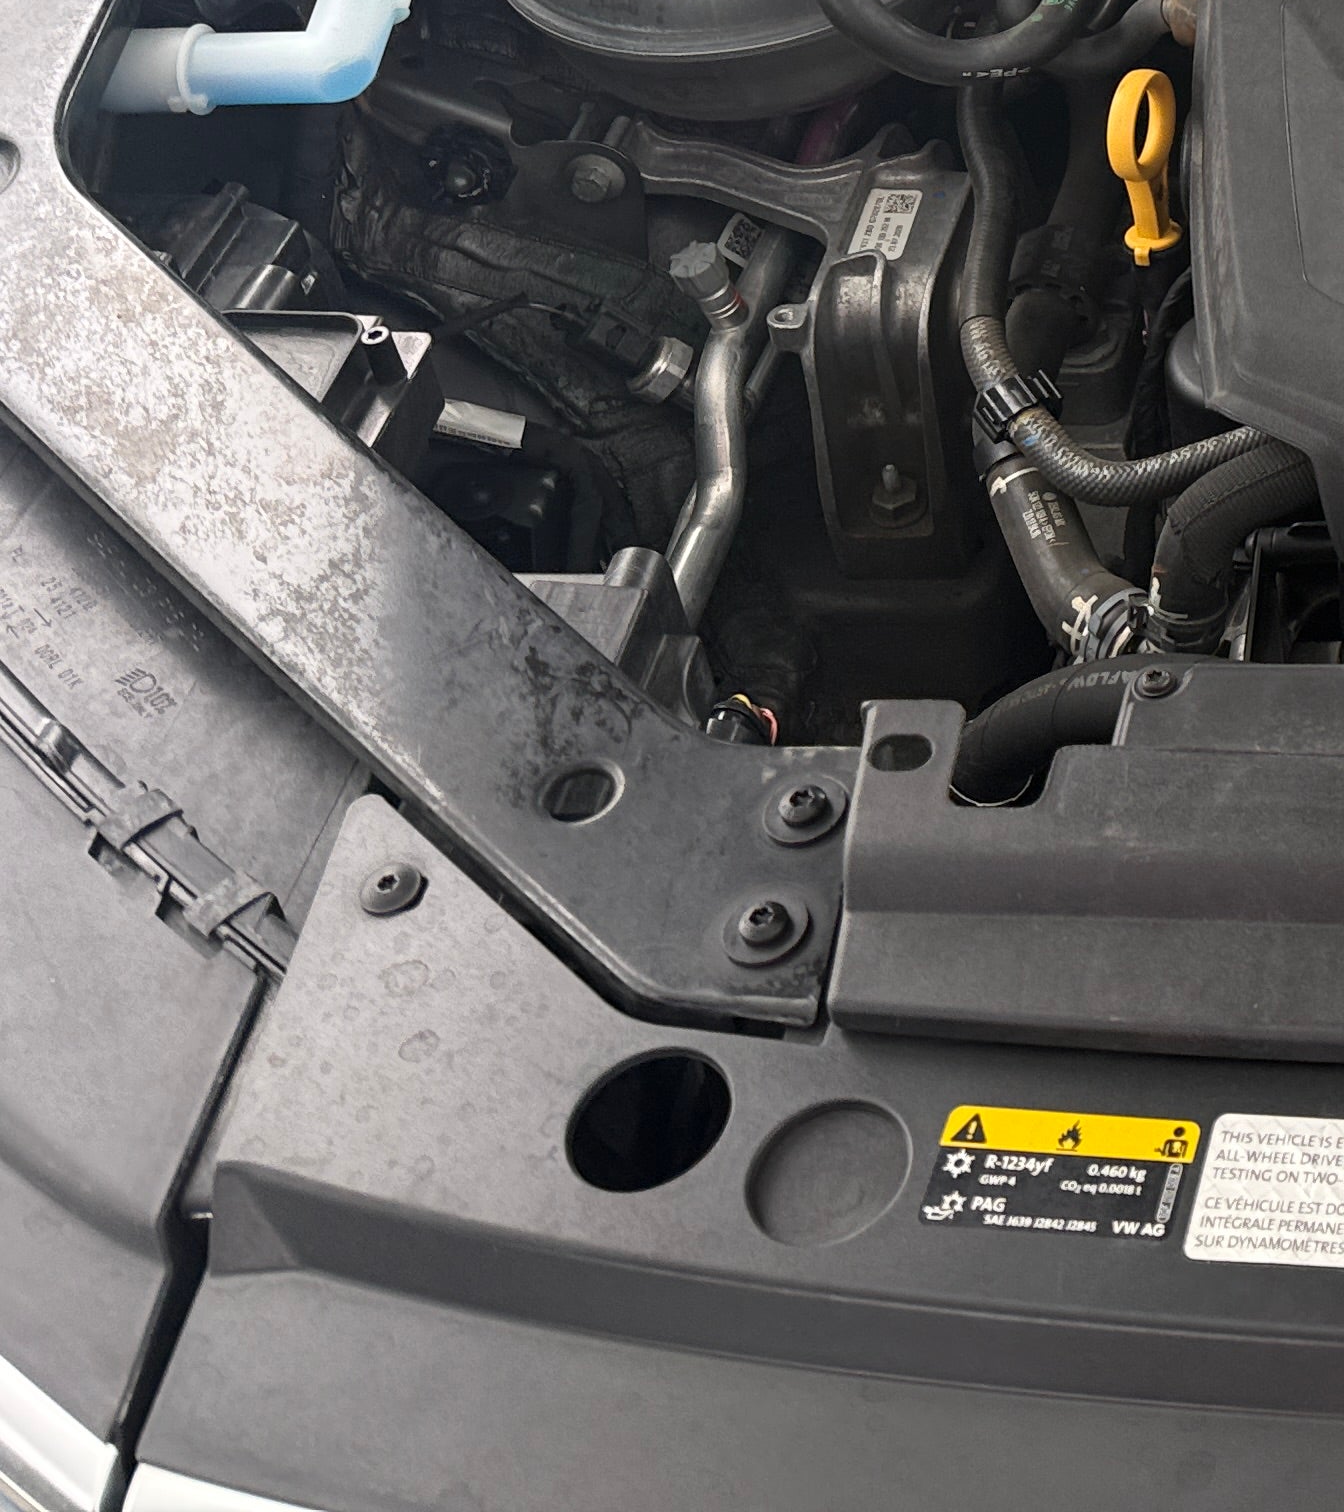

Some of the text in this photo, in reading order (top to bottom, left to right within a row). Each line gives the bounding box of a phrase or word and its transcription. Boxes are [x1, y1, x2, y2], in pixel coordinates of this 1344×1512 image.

[1221, 1130, 1253, 1144] THIS
[1259, 1133, 1314, 1148] VEHICLE
[1319, 1137, 1332, 1148] IS
[984, 1155, 1054, 1177] R-1234yf
[1215, 1149, 1297, 1164] ALL-WHEEL
[1300, 1153, 1344, 1167] DRIVE
[1087, 1164, 1147, 1183] 0.460 kg
[1213, 1167, 1273, 1182] TESTING
[1276, 1170, 1299, 1183] ON
[970, 1196, 1007, 1212] PAG
[1204, 1196, 1221, 1209] CE
[1226, 1196, 1295, 1213] VÉHICULE
[1299, 1201, 1323, 1214] EST
[1112, 1221, 1165, 1237] VW AG
[1200, 1215, 1275, 1231] INTÉGRALE
[1194, 1234, 1224, 1249] SUR
